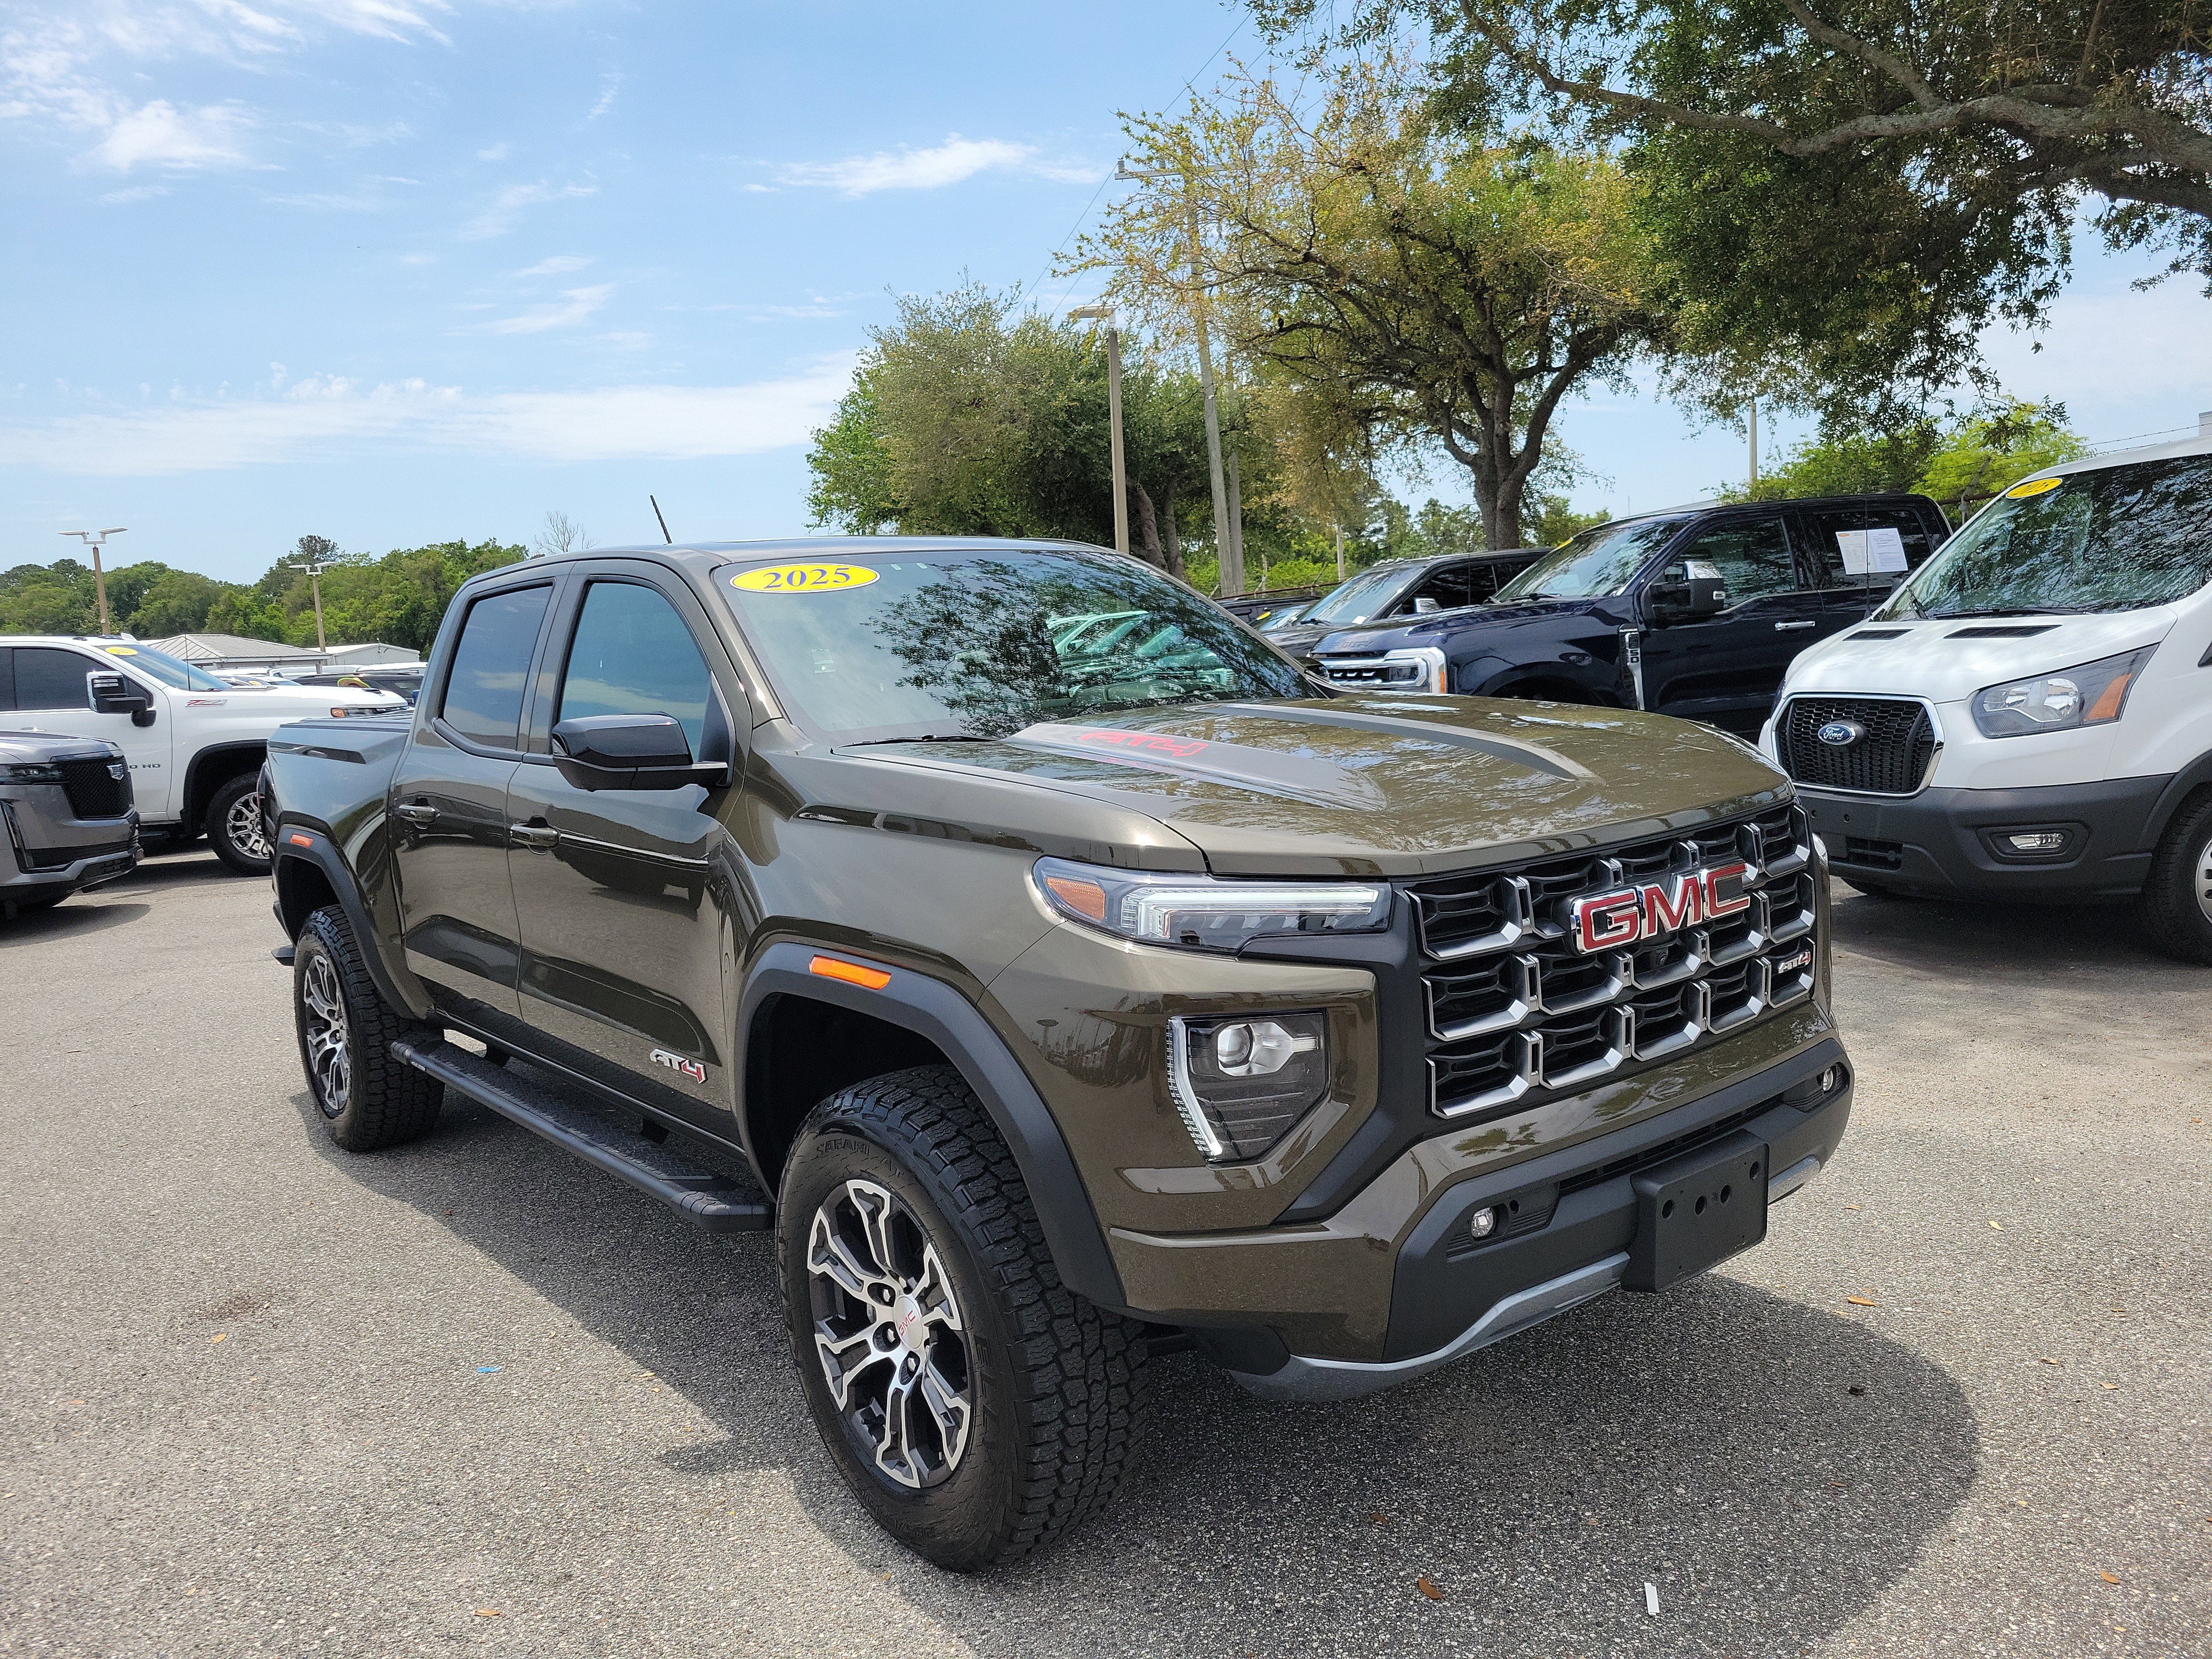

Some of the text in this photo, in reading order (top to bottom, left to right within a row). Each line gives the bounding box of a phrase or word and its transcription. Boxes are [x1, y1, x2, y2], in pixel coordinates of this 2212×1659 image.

[763, 567, 851, 589] 2025
[1079, 731, 1209, 757] AT4
[1823, 727, 1844, 740] Ford
[1570, 860, 1751, 955] GMC
[1778, 950, 1811, 974] AT4
[649, 1048, 707, 1084] AT4
[898, 1310, 916, 1336] GMC
